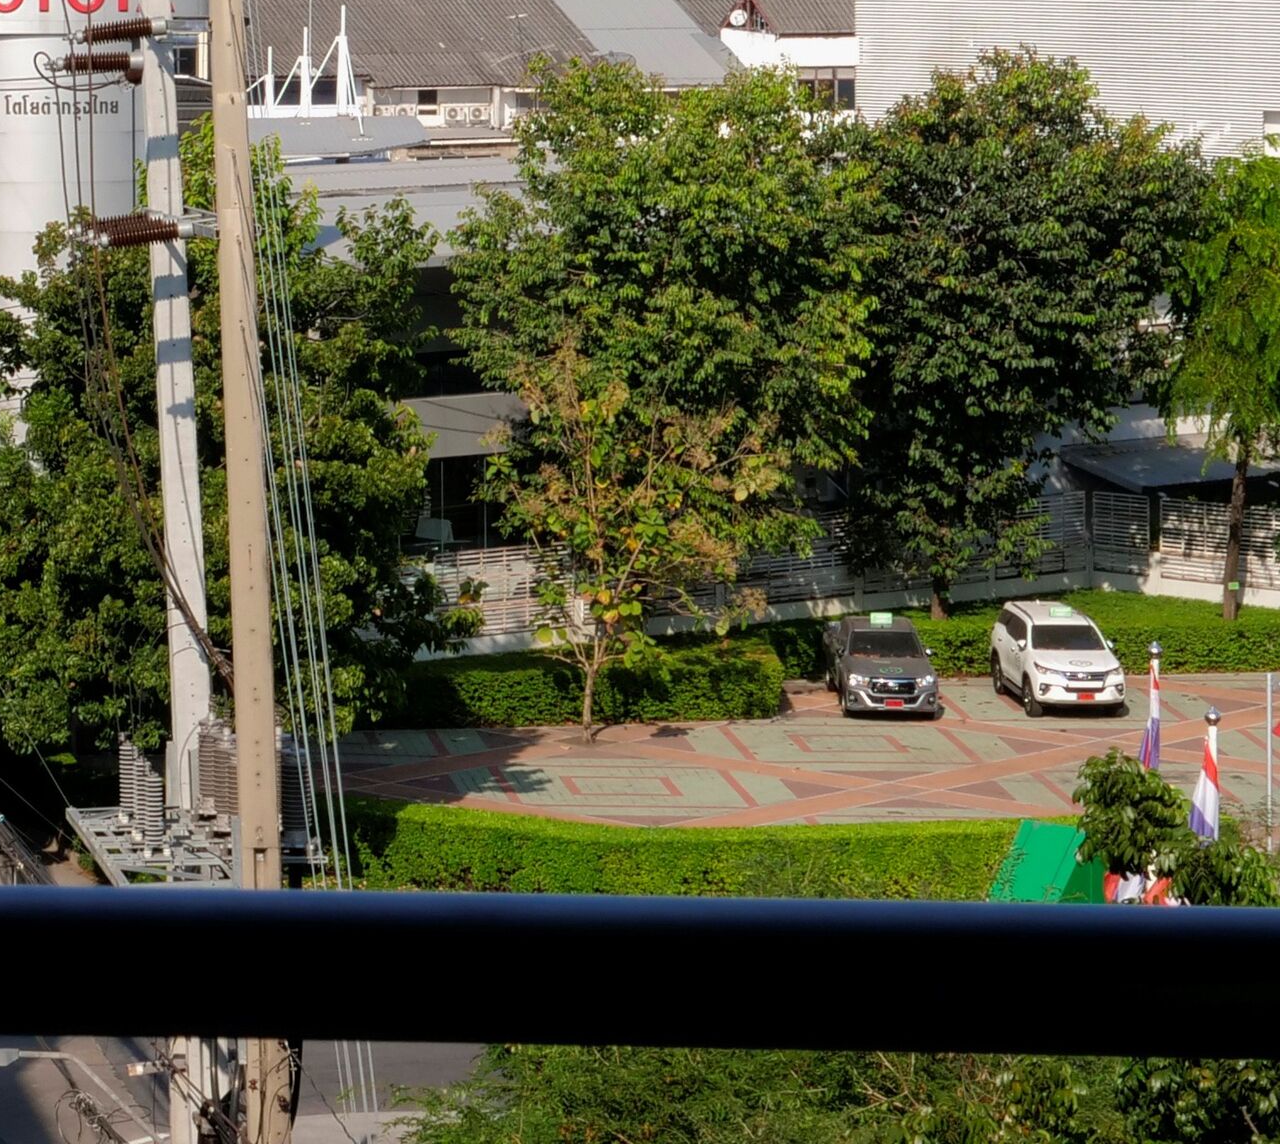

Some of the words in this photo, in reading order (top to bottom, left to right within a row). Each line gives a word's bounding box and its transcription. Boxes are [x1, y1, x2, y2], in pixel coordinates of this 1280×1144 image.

[4, 94, 119, 120] โตโยต้ากรุงไทย
